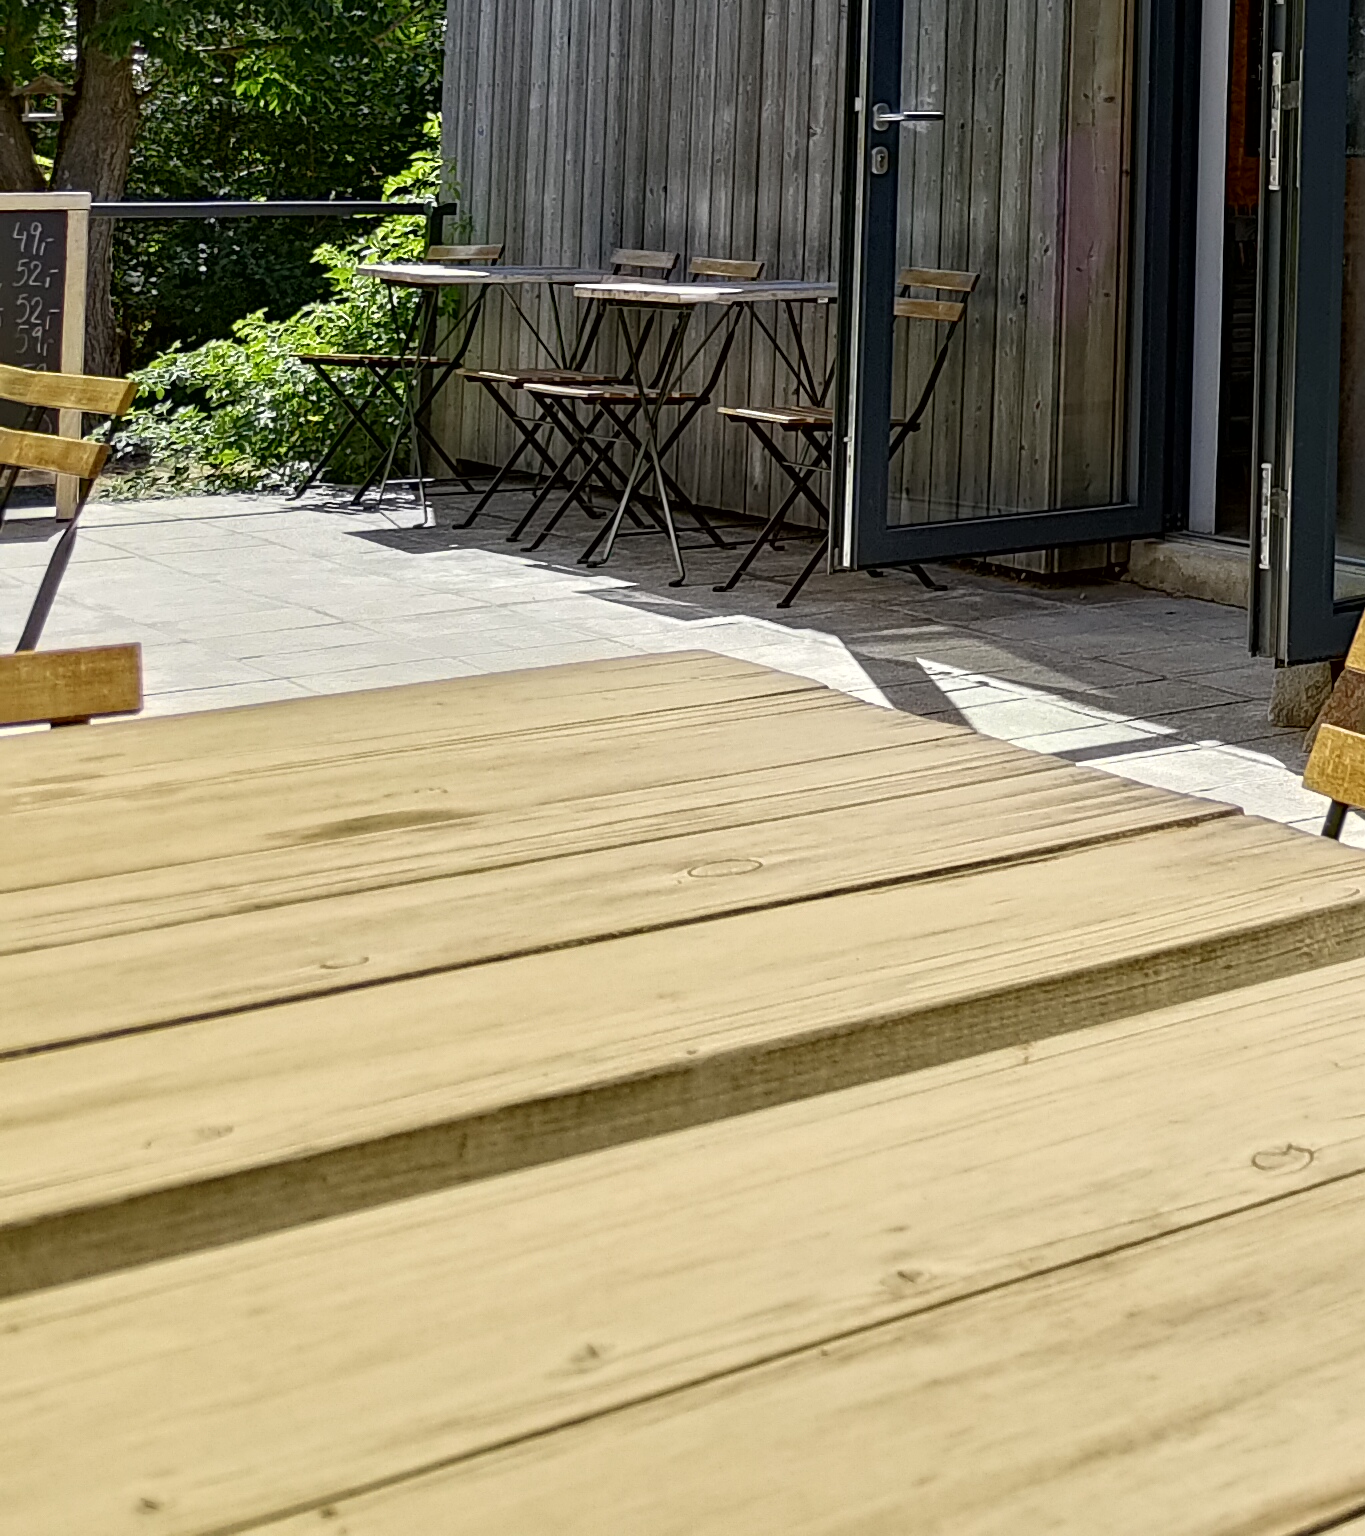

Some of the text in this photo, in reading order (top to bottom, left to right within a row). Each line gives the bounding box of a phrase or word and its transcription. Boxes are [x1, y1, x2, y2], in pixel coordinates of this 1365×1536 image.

[12, 221, 55, 256] 49,-
[12, 259, 60, 288] 52,-
[15, 293, 61, 330] 52,-
